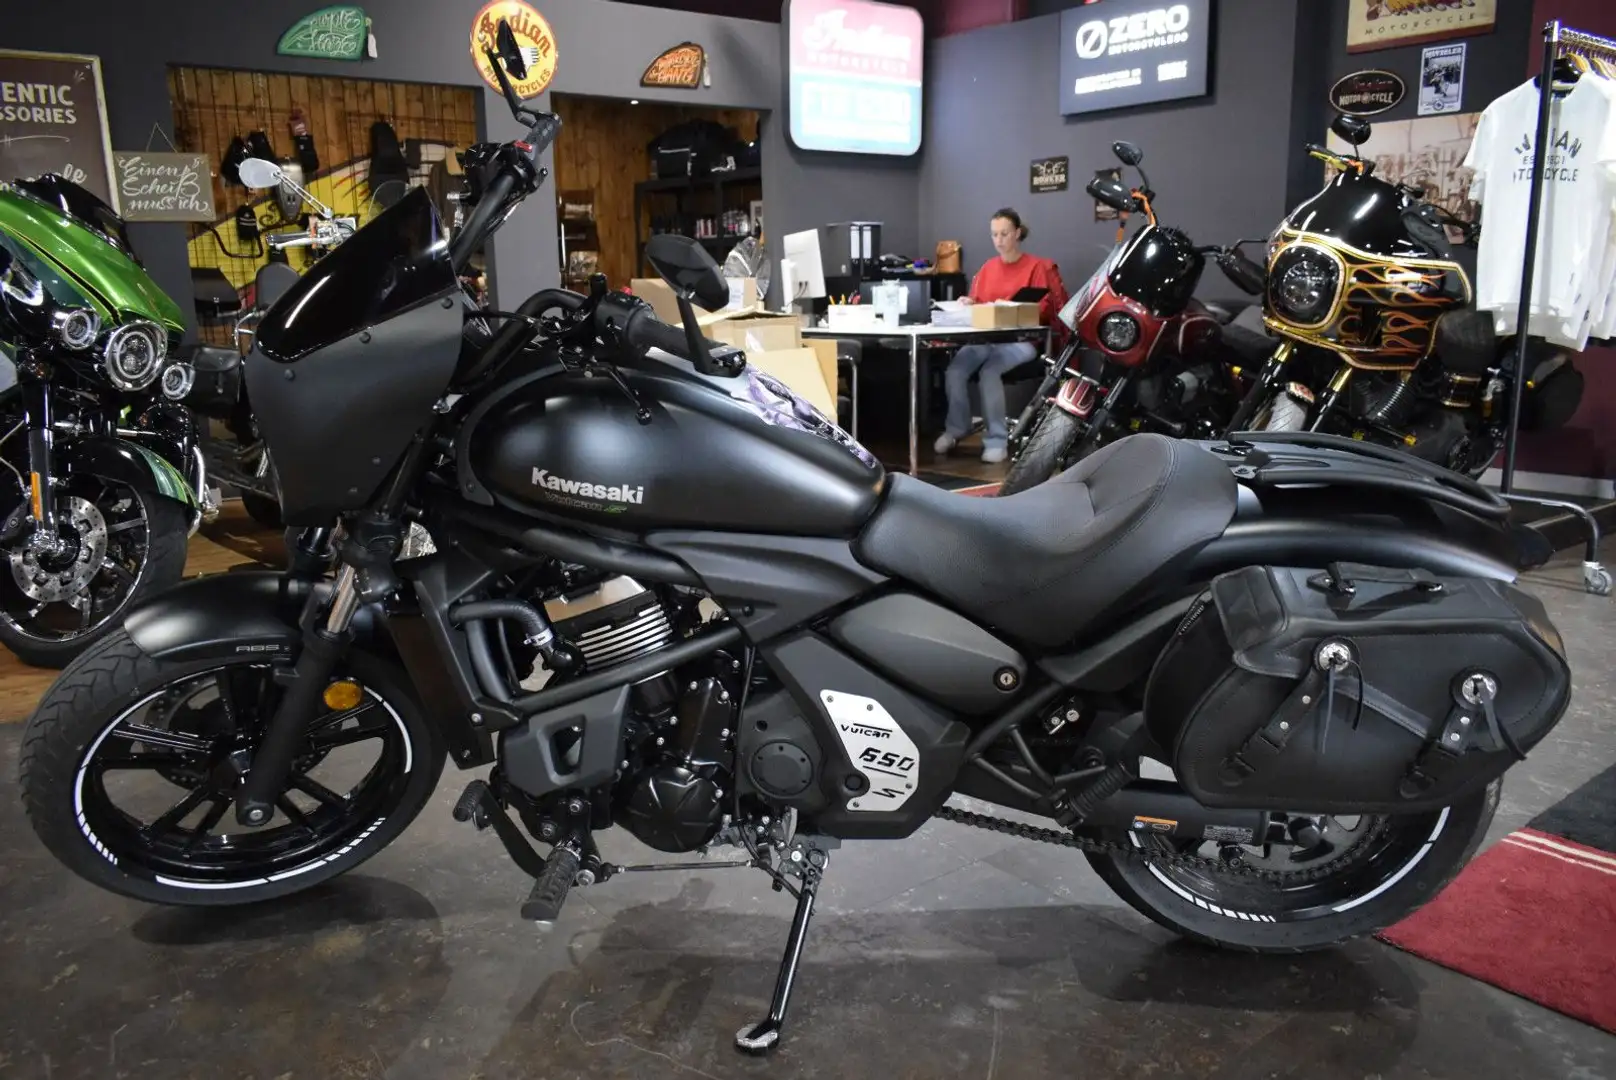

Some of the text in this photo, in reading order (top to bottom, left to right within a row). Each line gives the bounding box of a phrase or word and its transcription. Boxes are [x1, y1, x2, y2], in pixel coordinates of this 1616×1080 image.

[1108, 4, 1189, 43] ZERO
[1364, 13, 1476, 36] MOTORCYCLE
[119, 156, 179, 178] Einen
[122, 172, 201, 199] Scheiß
[531, 466, 644, 504] Kawasaki
[235, 644, 280, 653] ABS
[859, 747, 916, 771] 650
